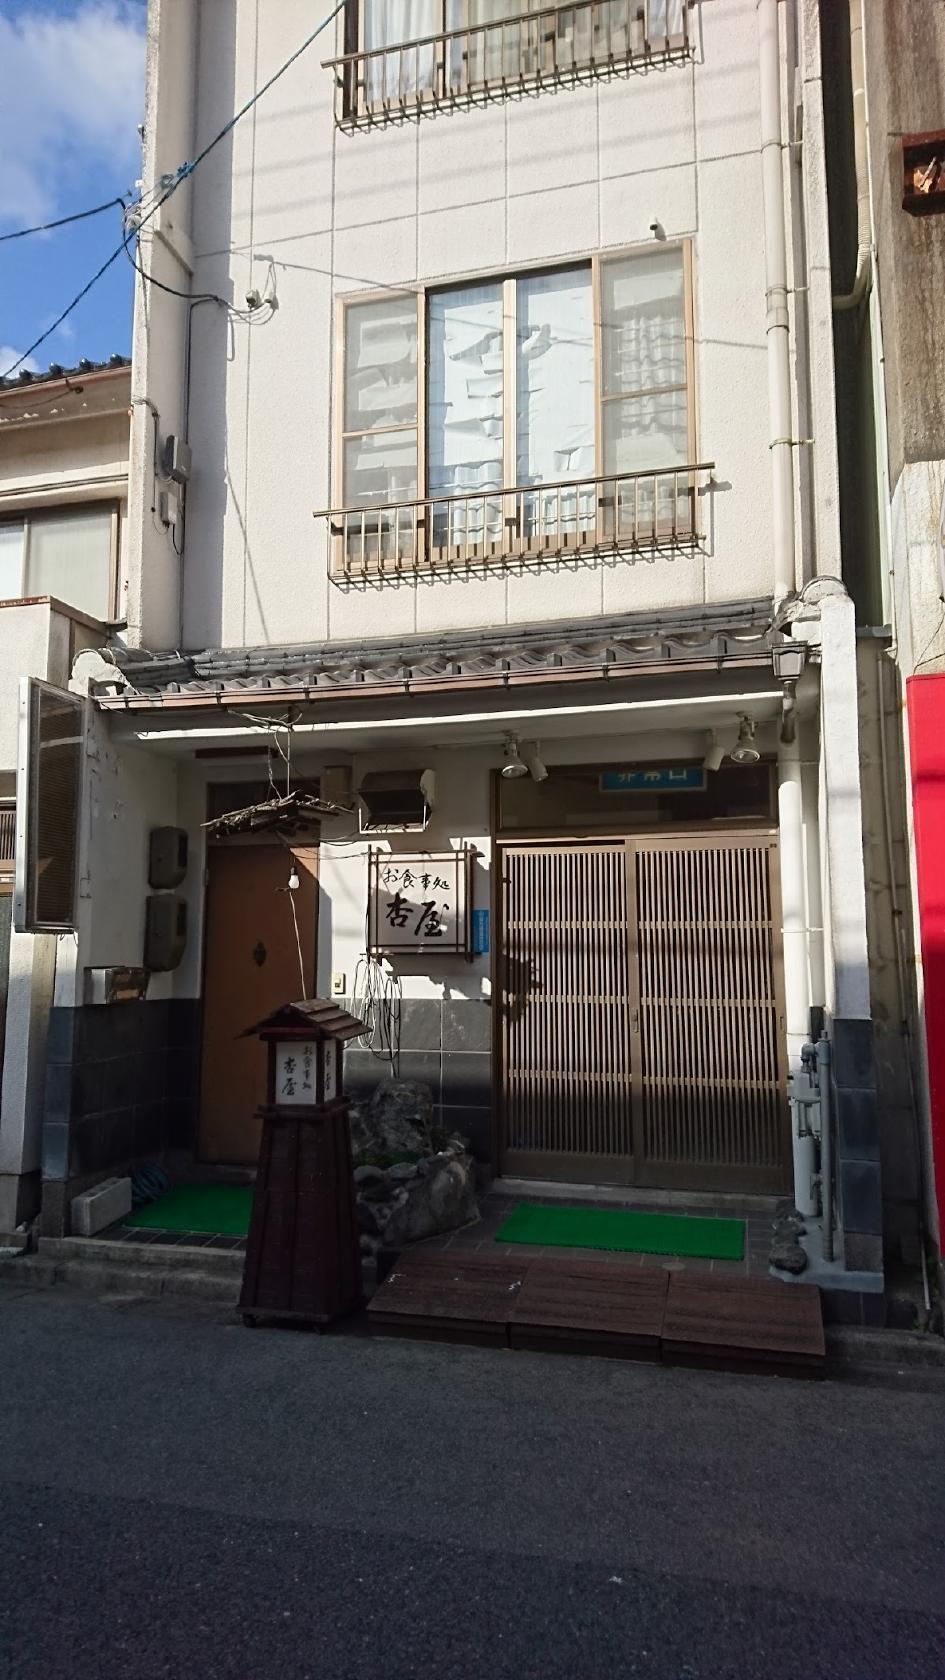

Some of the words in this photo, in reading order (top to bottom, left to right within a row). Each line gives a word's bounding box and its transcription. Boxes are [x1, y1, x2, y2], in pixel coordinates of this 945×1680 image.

[382, 868, 451, 890] お食事処
[385, 892, 450, 937] 杏屋
[281, 1056, 297, 1096] 杏屋
